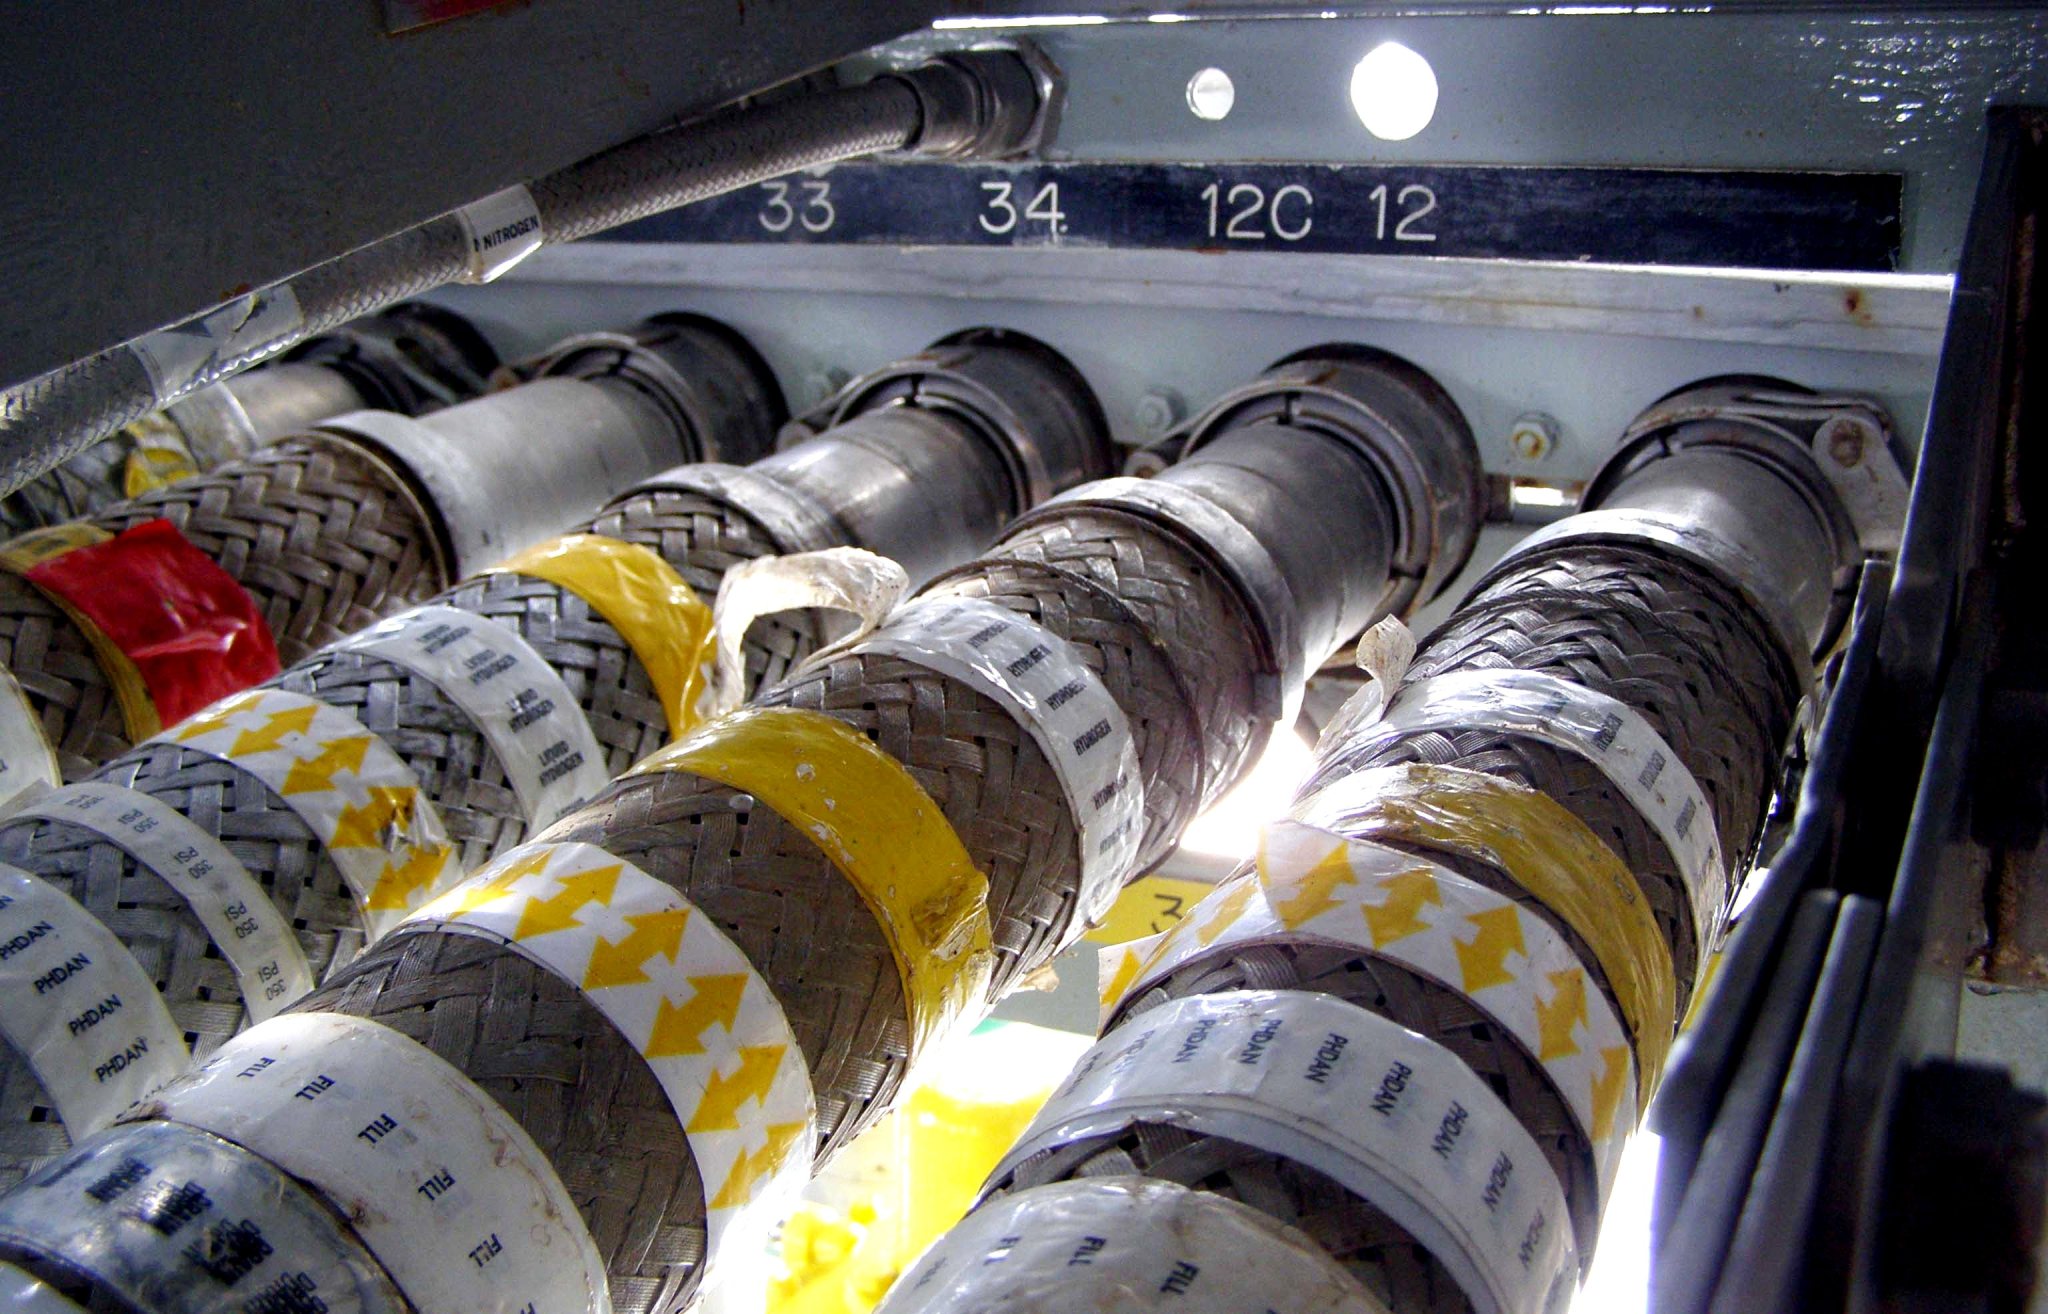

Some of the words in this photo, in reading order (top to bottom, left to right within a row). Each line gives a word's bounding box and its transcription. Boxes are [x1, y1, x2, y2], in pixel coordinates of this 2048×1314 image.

[758, 182, 836, 232] 33
[1200, 182, 1313, 241] 12C
[1368, 184, 1438, 242] 12
[483, 215, 539, 250] NITROGEN
[1006, 643, 1052, 678] HYDROGEN
[1046, 677, 1088, 711] HYDROGEN
[1072, 718, 1112, 756] HYDROGEN
[539, 751, 585, 788] HYDROGEN
[173, 847, 199, 865] PSI
[188, 859, 214, 879] 350
[224, 901, 247, 921] PSI
[235, 917, 259, 939] 350
[33, 952, 92, 994] PHDAN
[258, 961, 279, 983] PSI
[265, 979, 287, 1001] 350
[68, 993, 123, 1036] PHDAN
[1171, 1019, 1217, 1063] PHDAN
[1239, 1019, 1282, 1065] PHDAN
[1304, 1032, 1349, 1084] PHDAN
[95, 1036, 150, 1082] PHDAN
[236, 1057, 275, 1077] FILL
[295, 1074, 335, 1100] FILL
[1370, 1059, 1414, 1117] PHDAN
[358, 1113, 399, 1145] FILL
[1430, 1100, 1469, 1160] PHDAN
[418, 1167, 456, 1201] FILL
[1480, 1150, 1514, 1213] PHDAN
[468, 1233, 503, 1268] FILL
[1068, 1236, 1107, 1267] FILL
[1160, 1260, 1200, 1295] FILL
